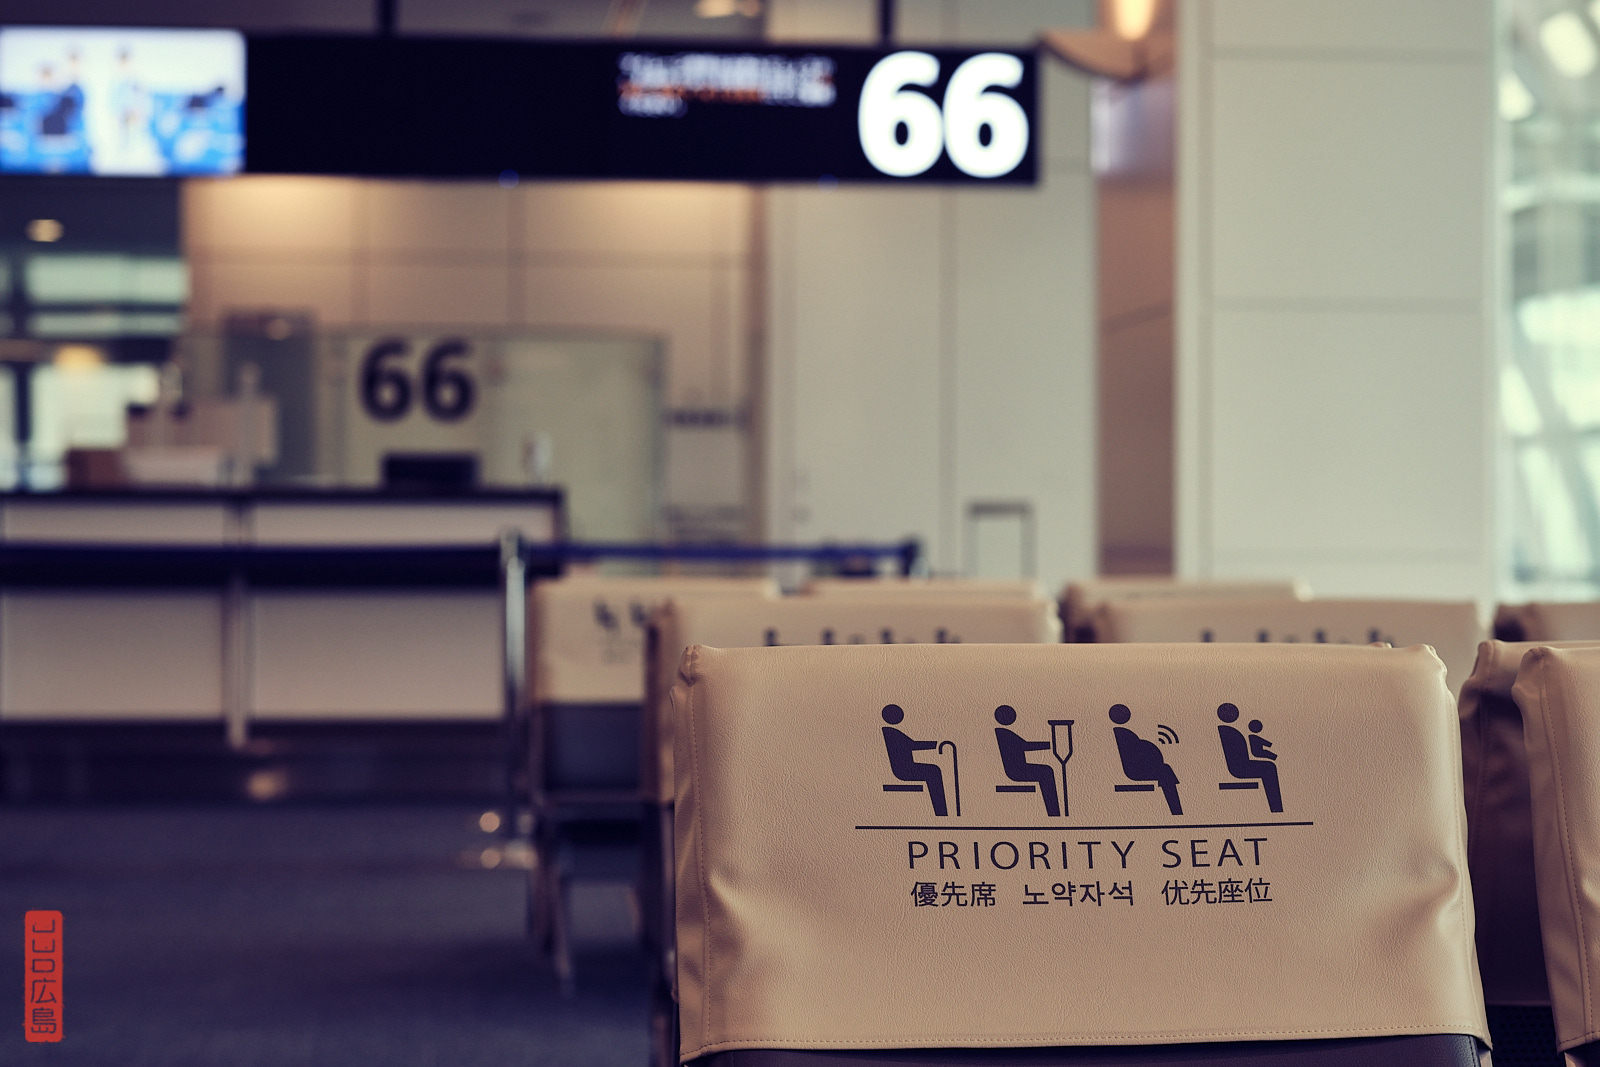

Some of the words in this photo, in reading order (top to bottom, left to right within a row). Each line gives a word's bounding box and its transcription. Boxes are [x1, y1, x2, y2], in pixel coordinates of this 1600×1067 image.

[858, 51, 1029, 178] 66
[359, 338, 476, 423] 66
[908, 840, 1136, 870] PRIORITY
[1162, 838, 1269, 868] SEAT
[911, 881, 997, 907] 優先席
[1022, 881, 1134, 907] 노약자석
[1161, 878, 1273, 905] 优先座位
